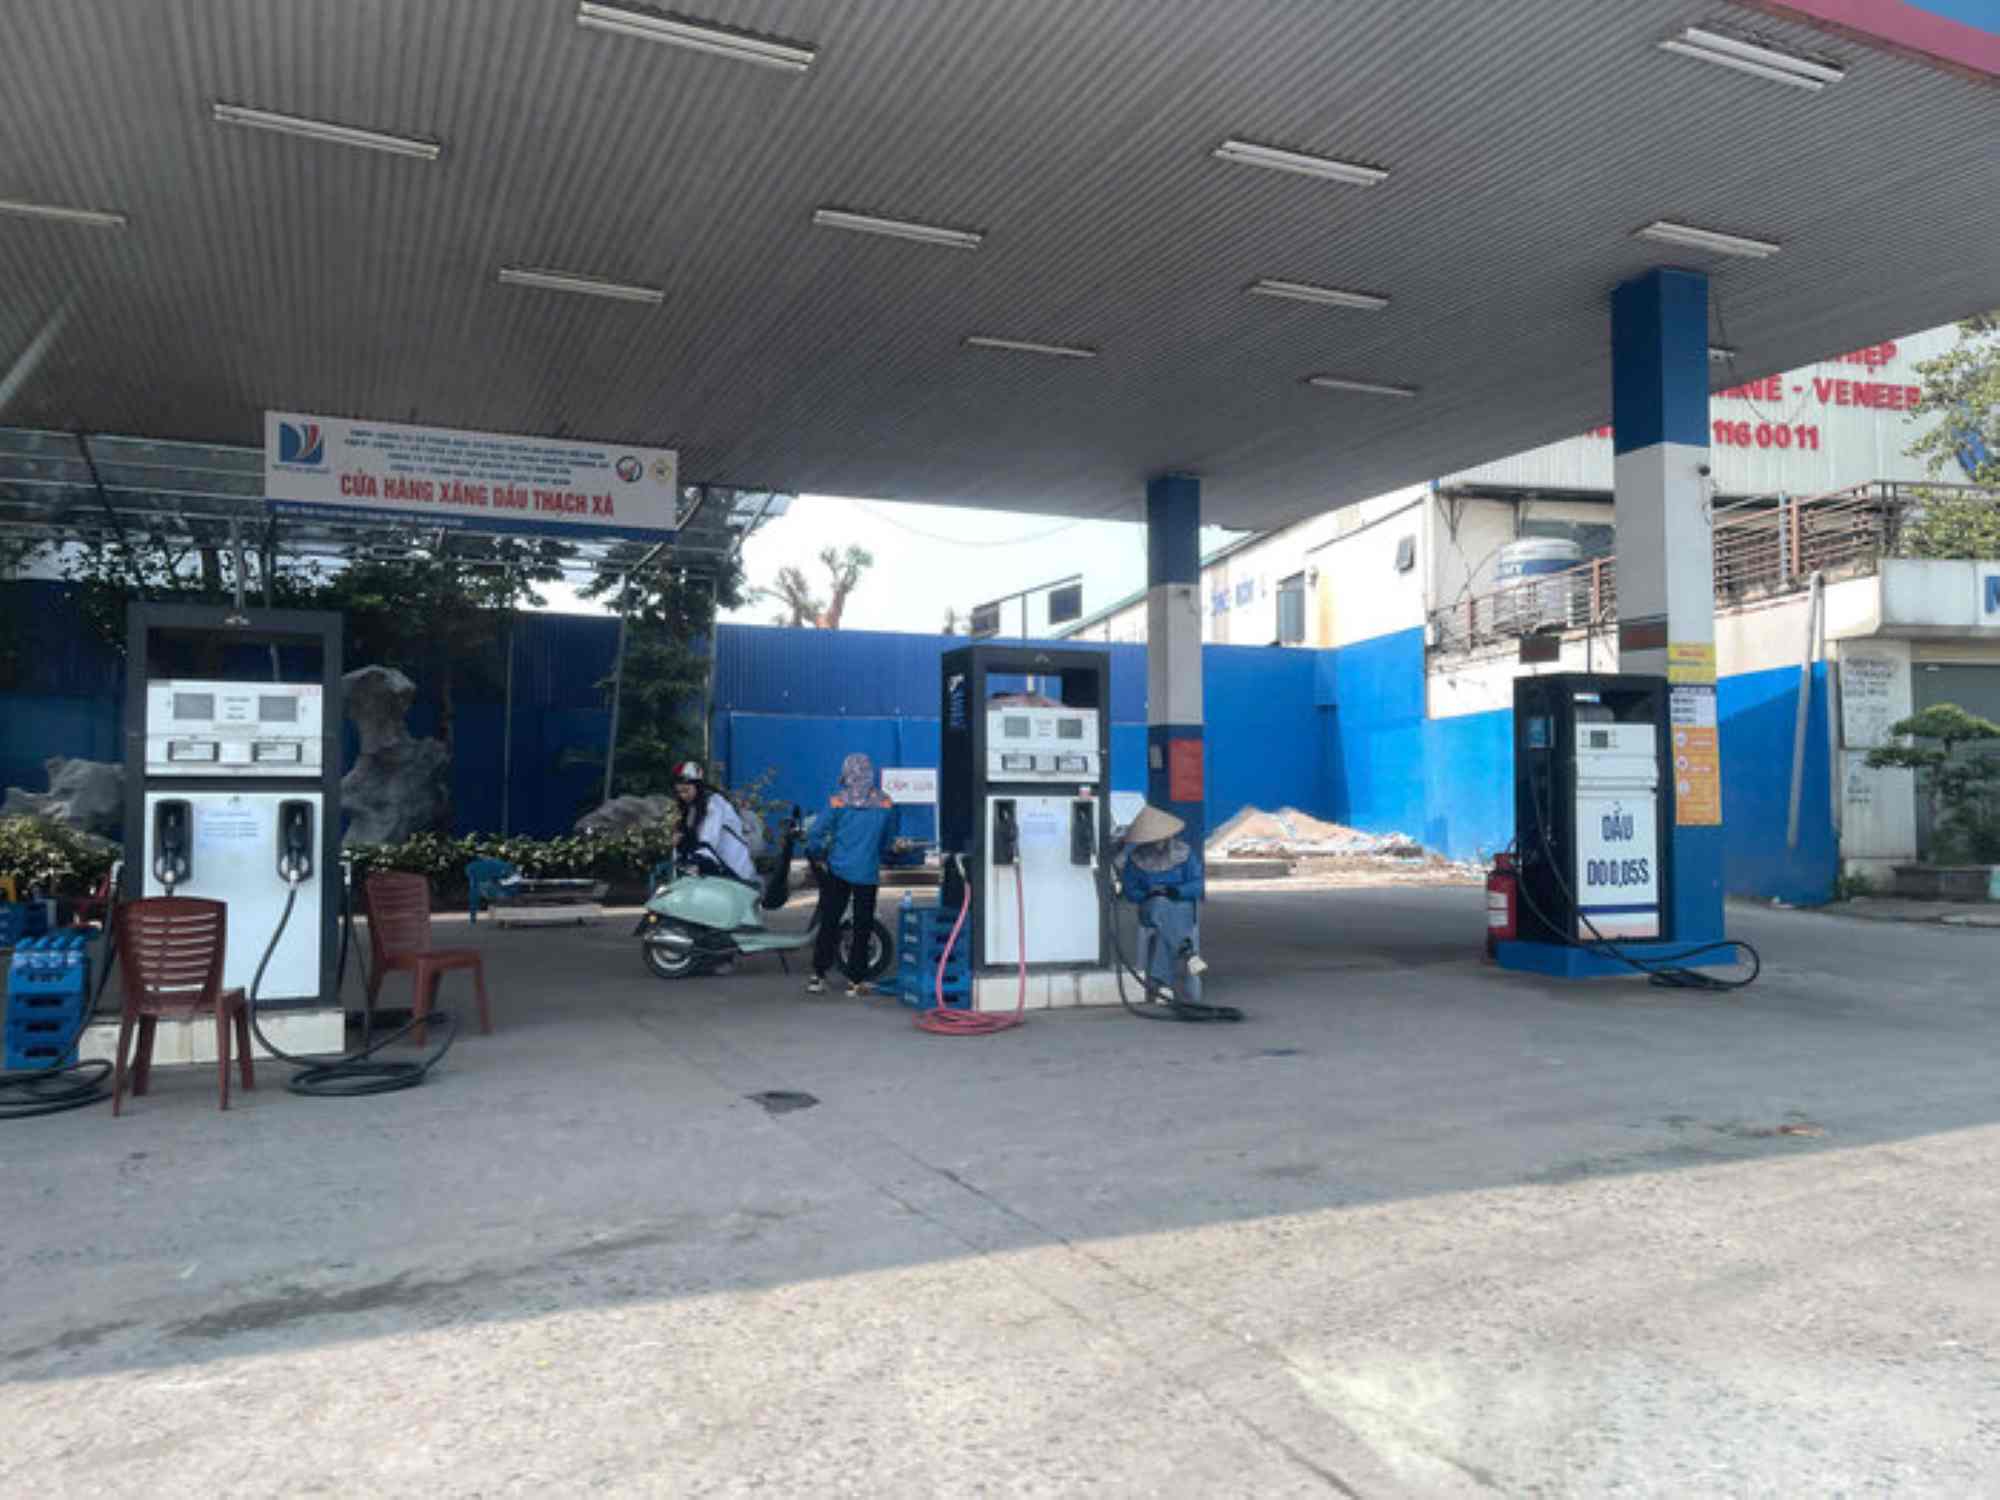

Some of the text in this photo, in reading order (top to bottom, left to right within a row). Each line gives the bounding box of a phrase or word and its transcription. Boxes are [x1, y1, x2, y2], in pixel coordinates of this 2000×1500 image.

[341, 467, 376, 497] CỬA
[384, 474, 433, 502] HÀNG
[439, 477, 489, 507] XĂNG
[532, 486, 588, 516] THẠCH
